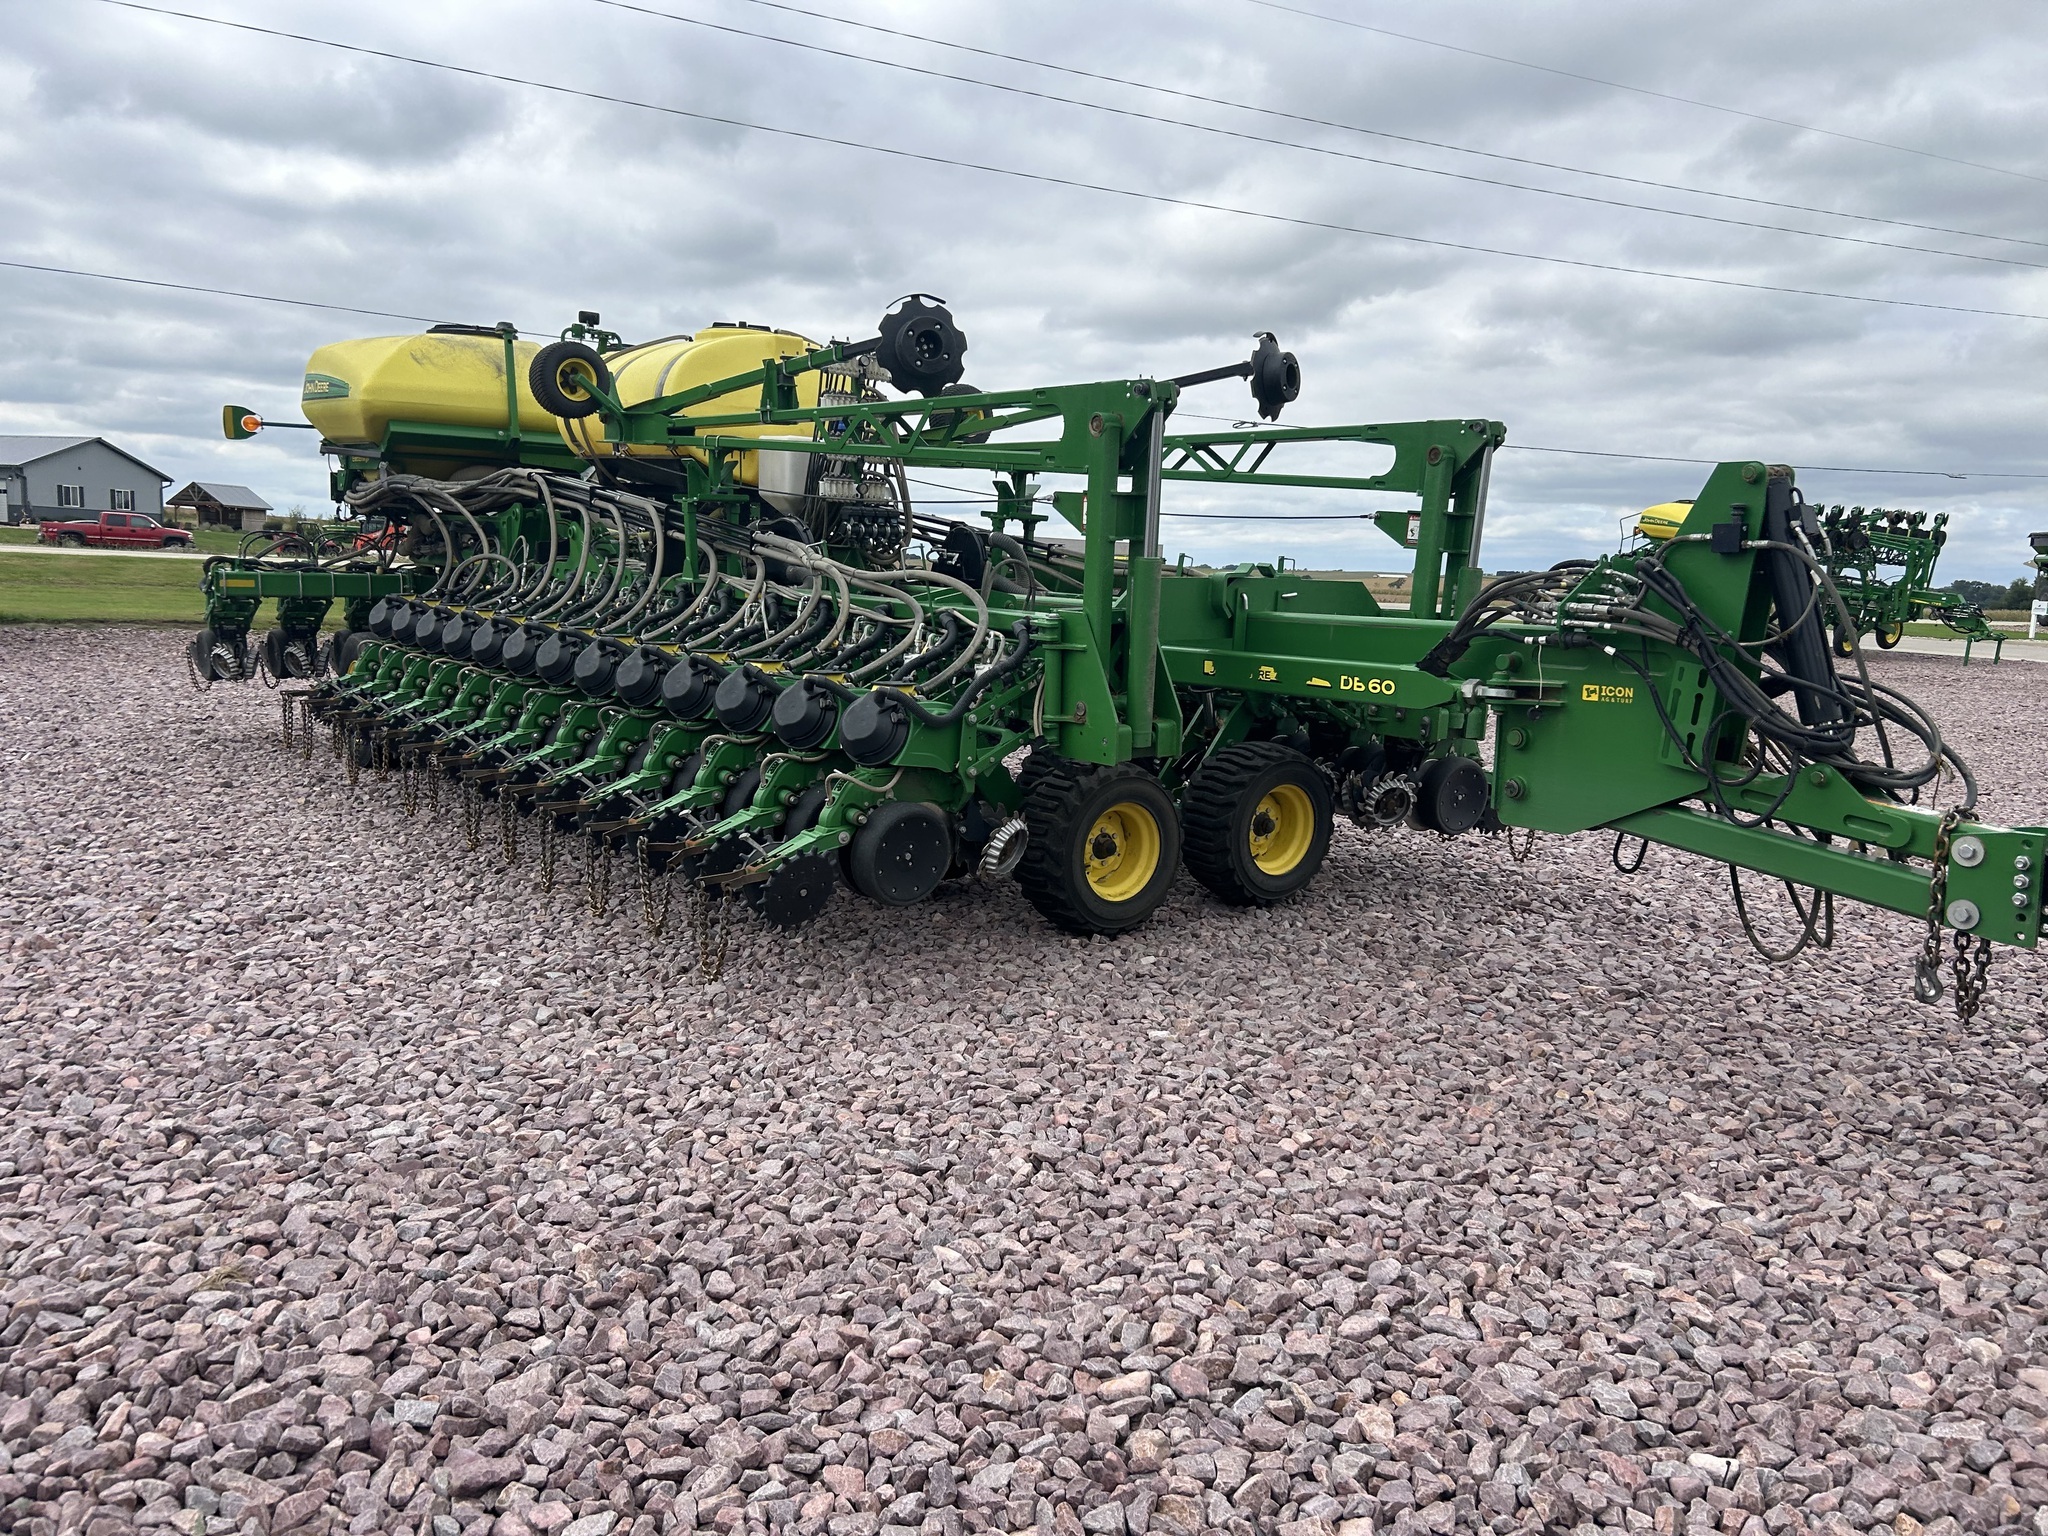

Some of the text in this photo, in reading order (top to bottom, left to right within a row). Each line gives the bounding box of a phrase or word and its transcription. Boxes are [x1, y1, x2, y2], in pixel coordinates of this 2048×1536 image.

[304, 380, 330, 394] JOHN DEERE
[1600, 685, 1634, 698] ICON
